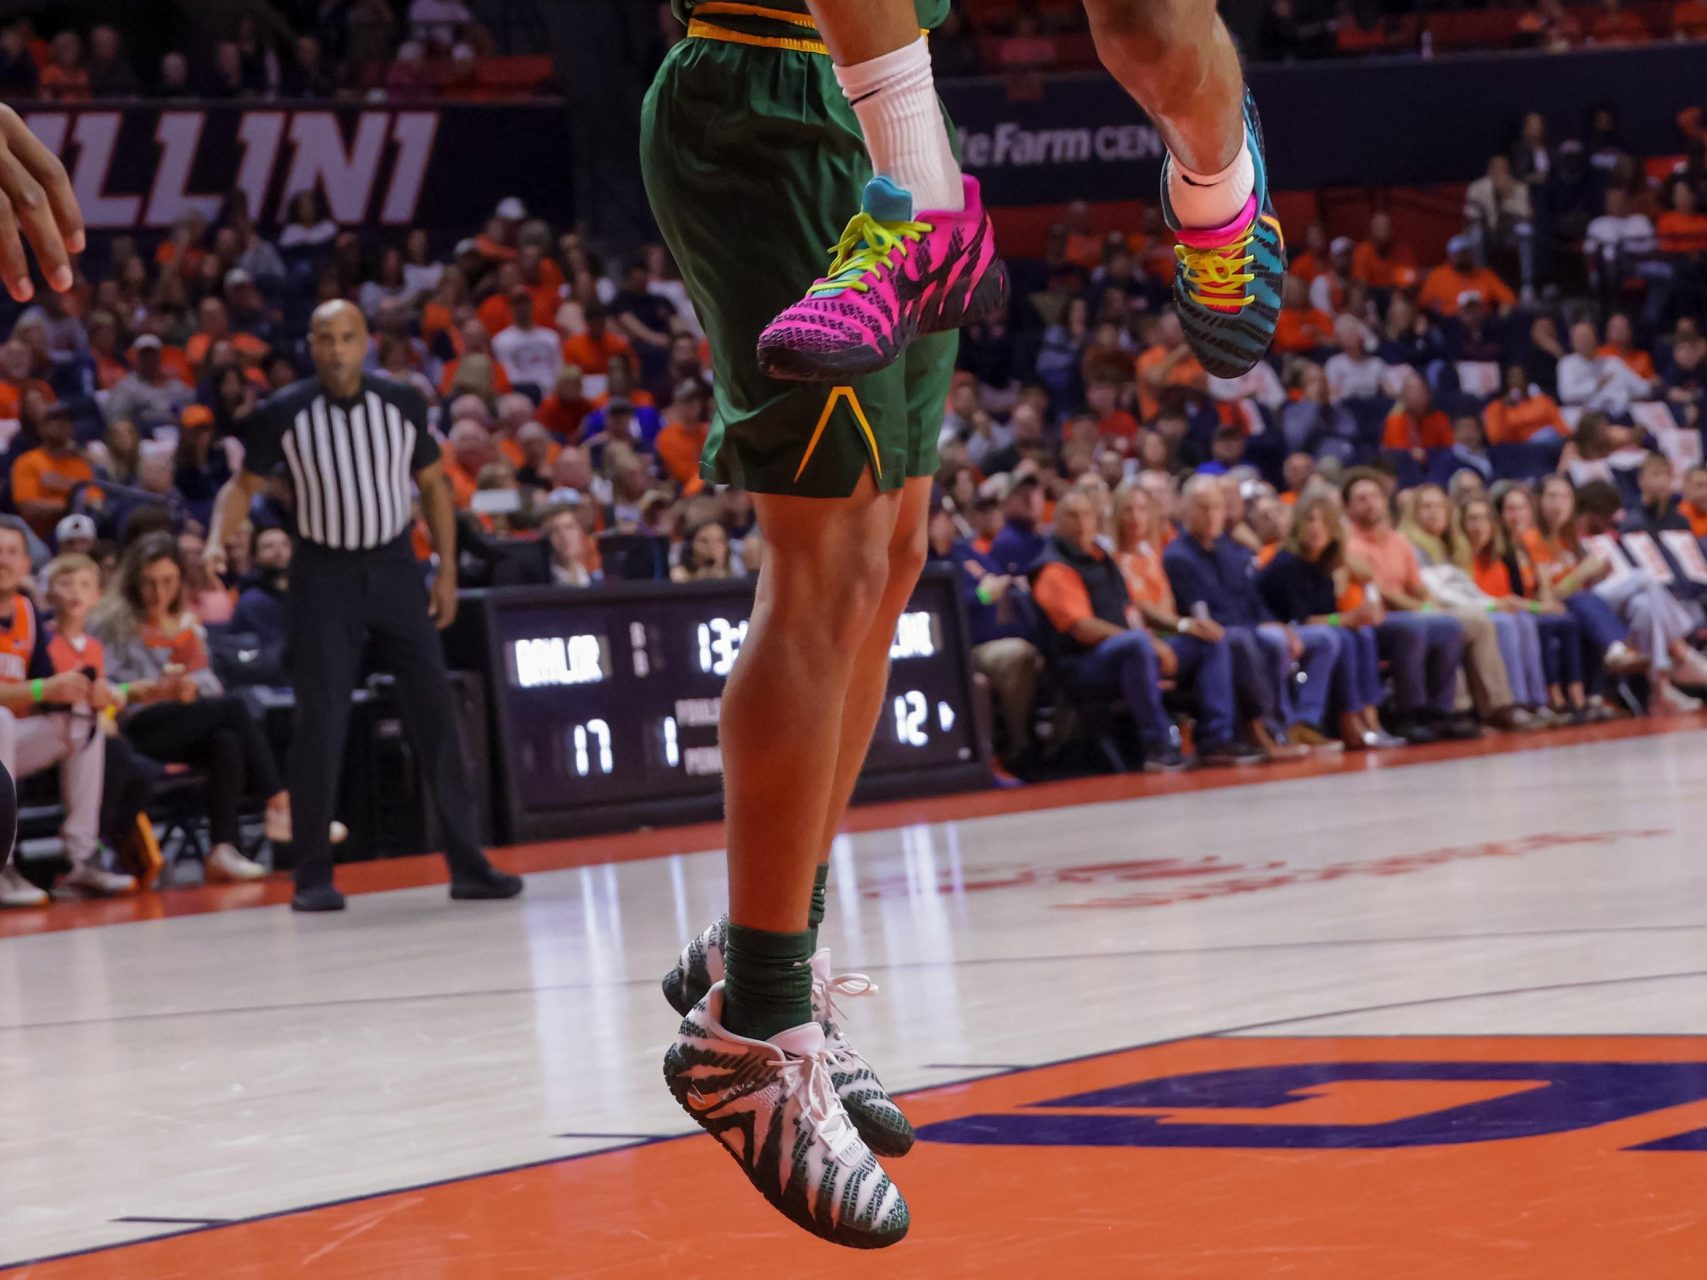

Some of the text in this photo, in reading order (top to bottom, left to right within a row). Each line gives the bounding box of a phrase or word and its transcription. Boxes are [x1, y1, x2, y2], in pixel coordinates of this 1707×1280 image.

[1095, 125, 1162, 160] CEN
[573, 718, 613, 776] 17
[894, 690, 929, 747] 12
